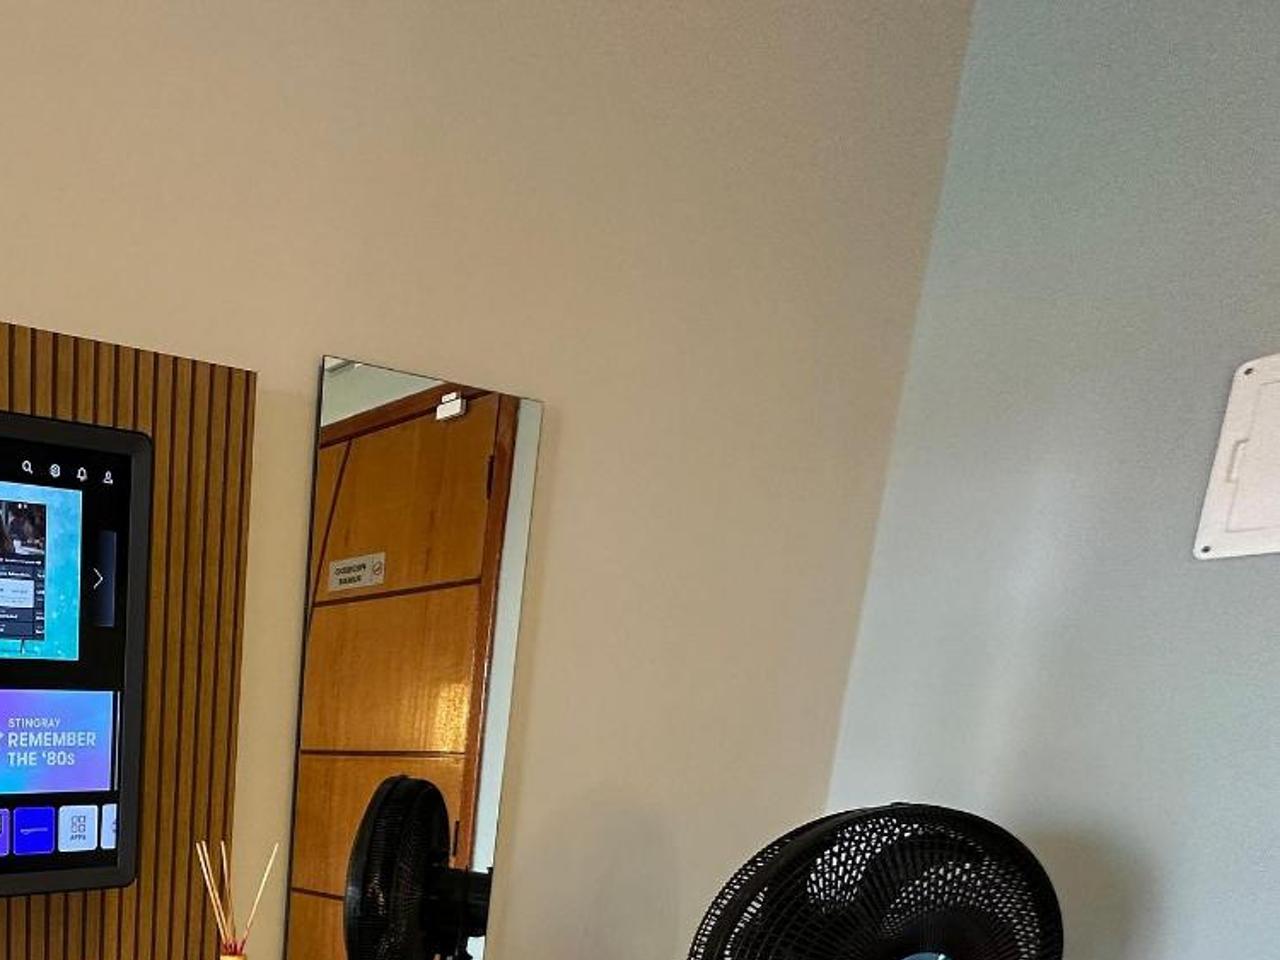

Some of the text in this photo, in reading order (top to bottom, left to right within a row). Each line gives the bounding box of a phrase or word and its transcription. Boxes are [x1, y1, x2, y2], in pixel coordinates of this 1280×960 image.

[8, 717, 61, 728] STINGRAY
[8, 731, 96, 747] REMEMBER
[8, 752, 37, 767] THE
